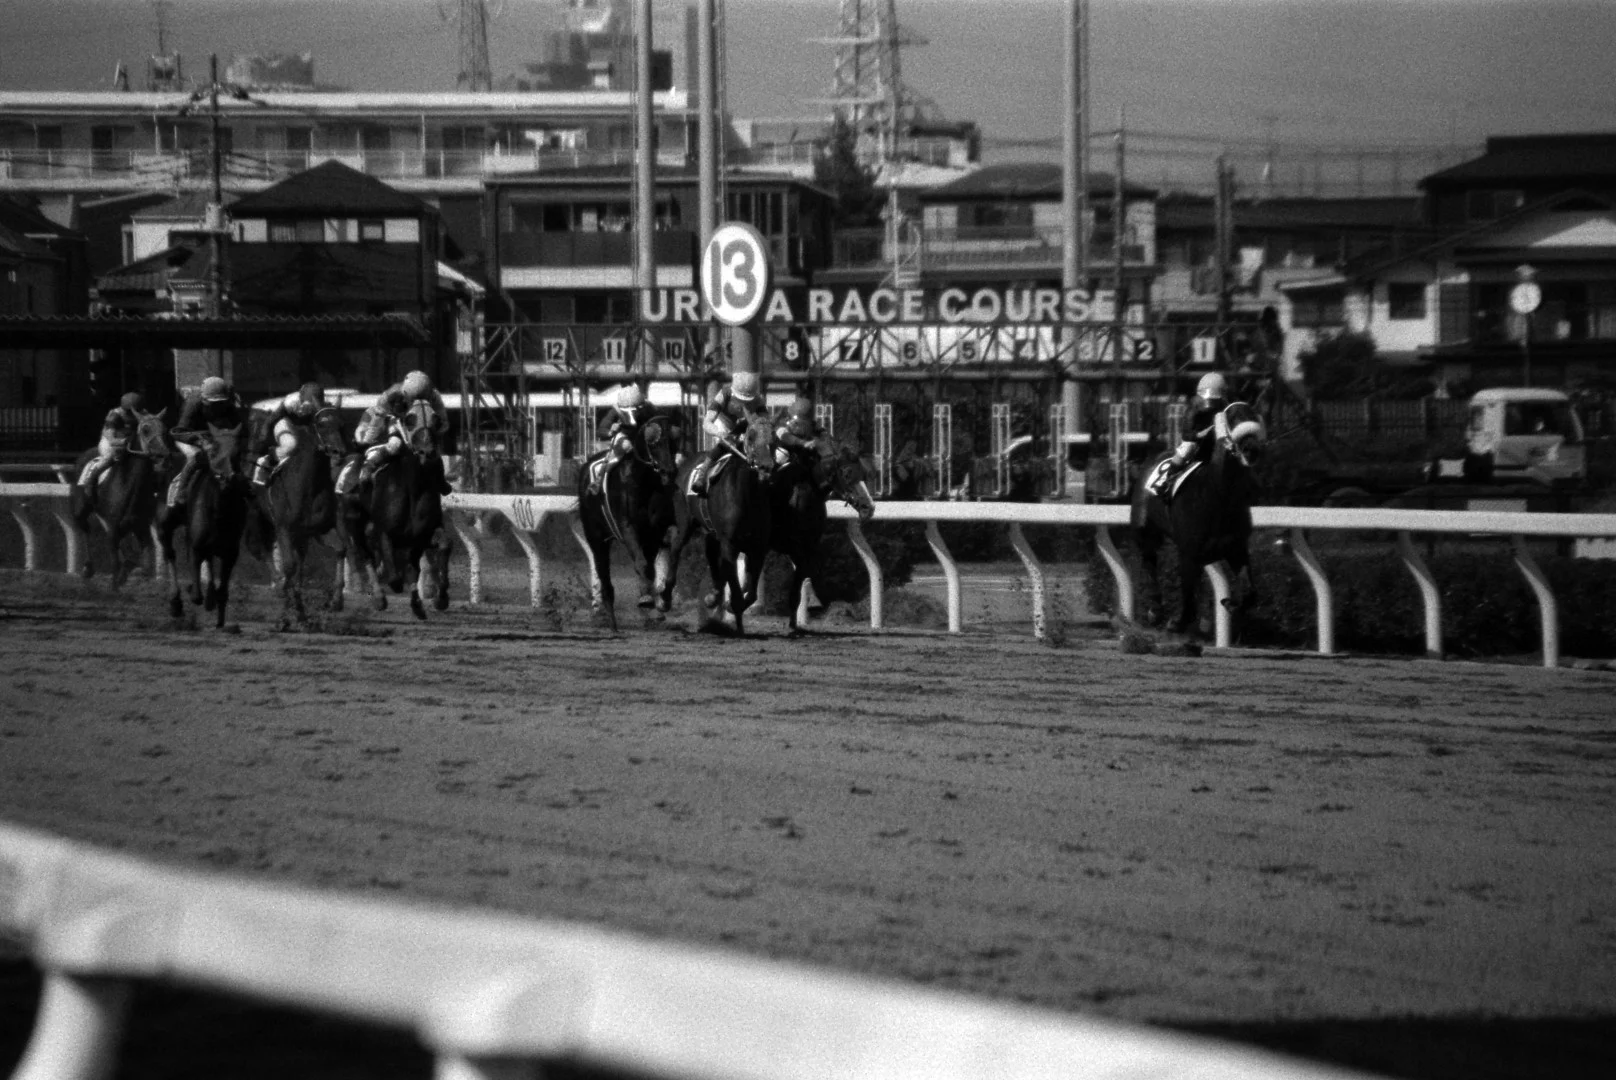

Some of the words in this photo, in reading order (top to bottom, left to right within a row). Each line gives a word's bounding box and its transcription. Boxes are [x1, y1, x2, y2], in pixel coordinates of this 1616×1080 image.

[710, 238, 758, 310] 13
[641, 288, 794, 322] URA
[808, 288, 924, 322] RACE
[938, 288, 1116, 322] COURSE
[547, 341, 563, 360] 12
[606, 341, 622, 360] 11
[665, 341, 682, 360] 10
[785, 340, 799, 361] 8
[844, 340, 858, 361] 7
[903, 340, 918, 360] 6
[962, 340, 976, 360] 5
[1019, 341, 1034, 360] 4
[1138, 340, 1153, 360] 2
